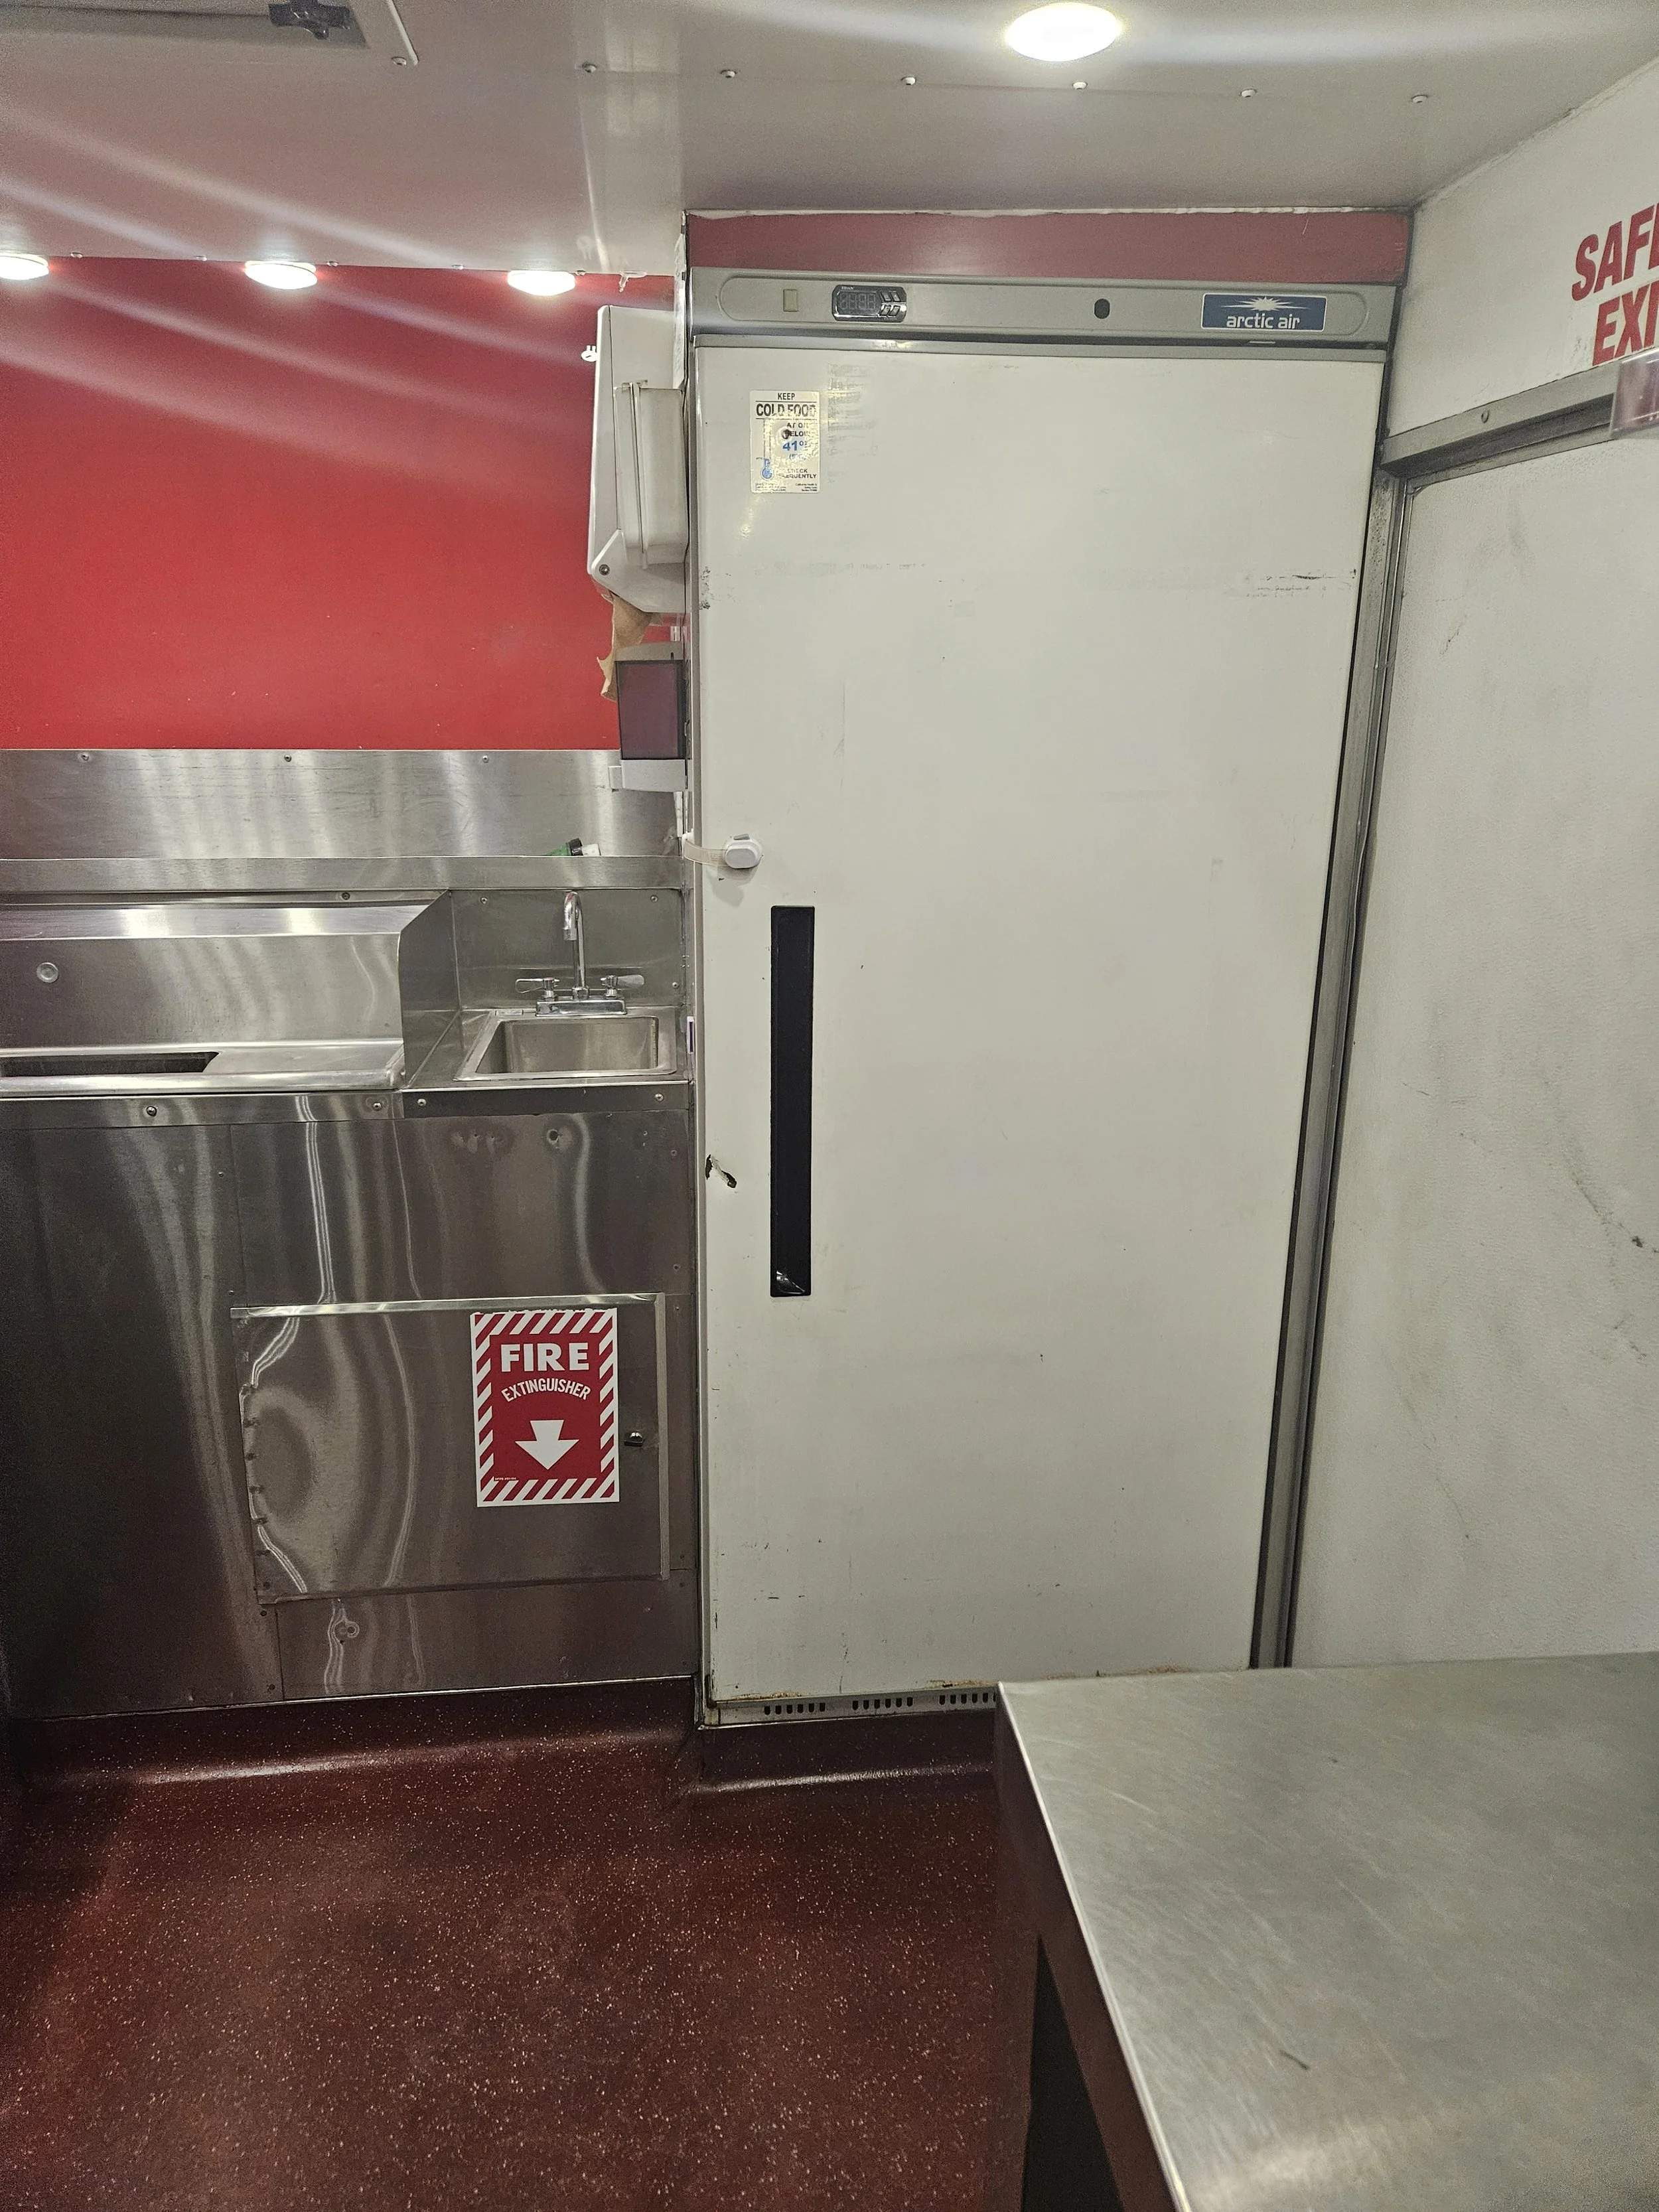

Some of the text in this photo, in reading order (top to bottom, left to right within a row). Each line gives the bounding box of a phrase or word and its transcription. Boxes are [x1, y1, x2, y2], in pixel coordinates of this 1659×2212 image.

[1226, 313, 1301, 329] arctic air
[756, 403, 785, 417] COLD
[501, 1342, 590, 1372] FIRE
[501, 1378, 592, 1402] EXTINGUISHER
